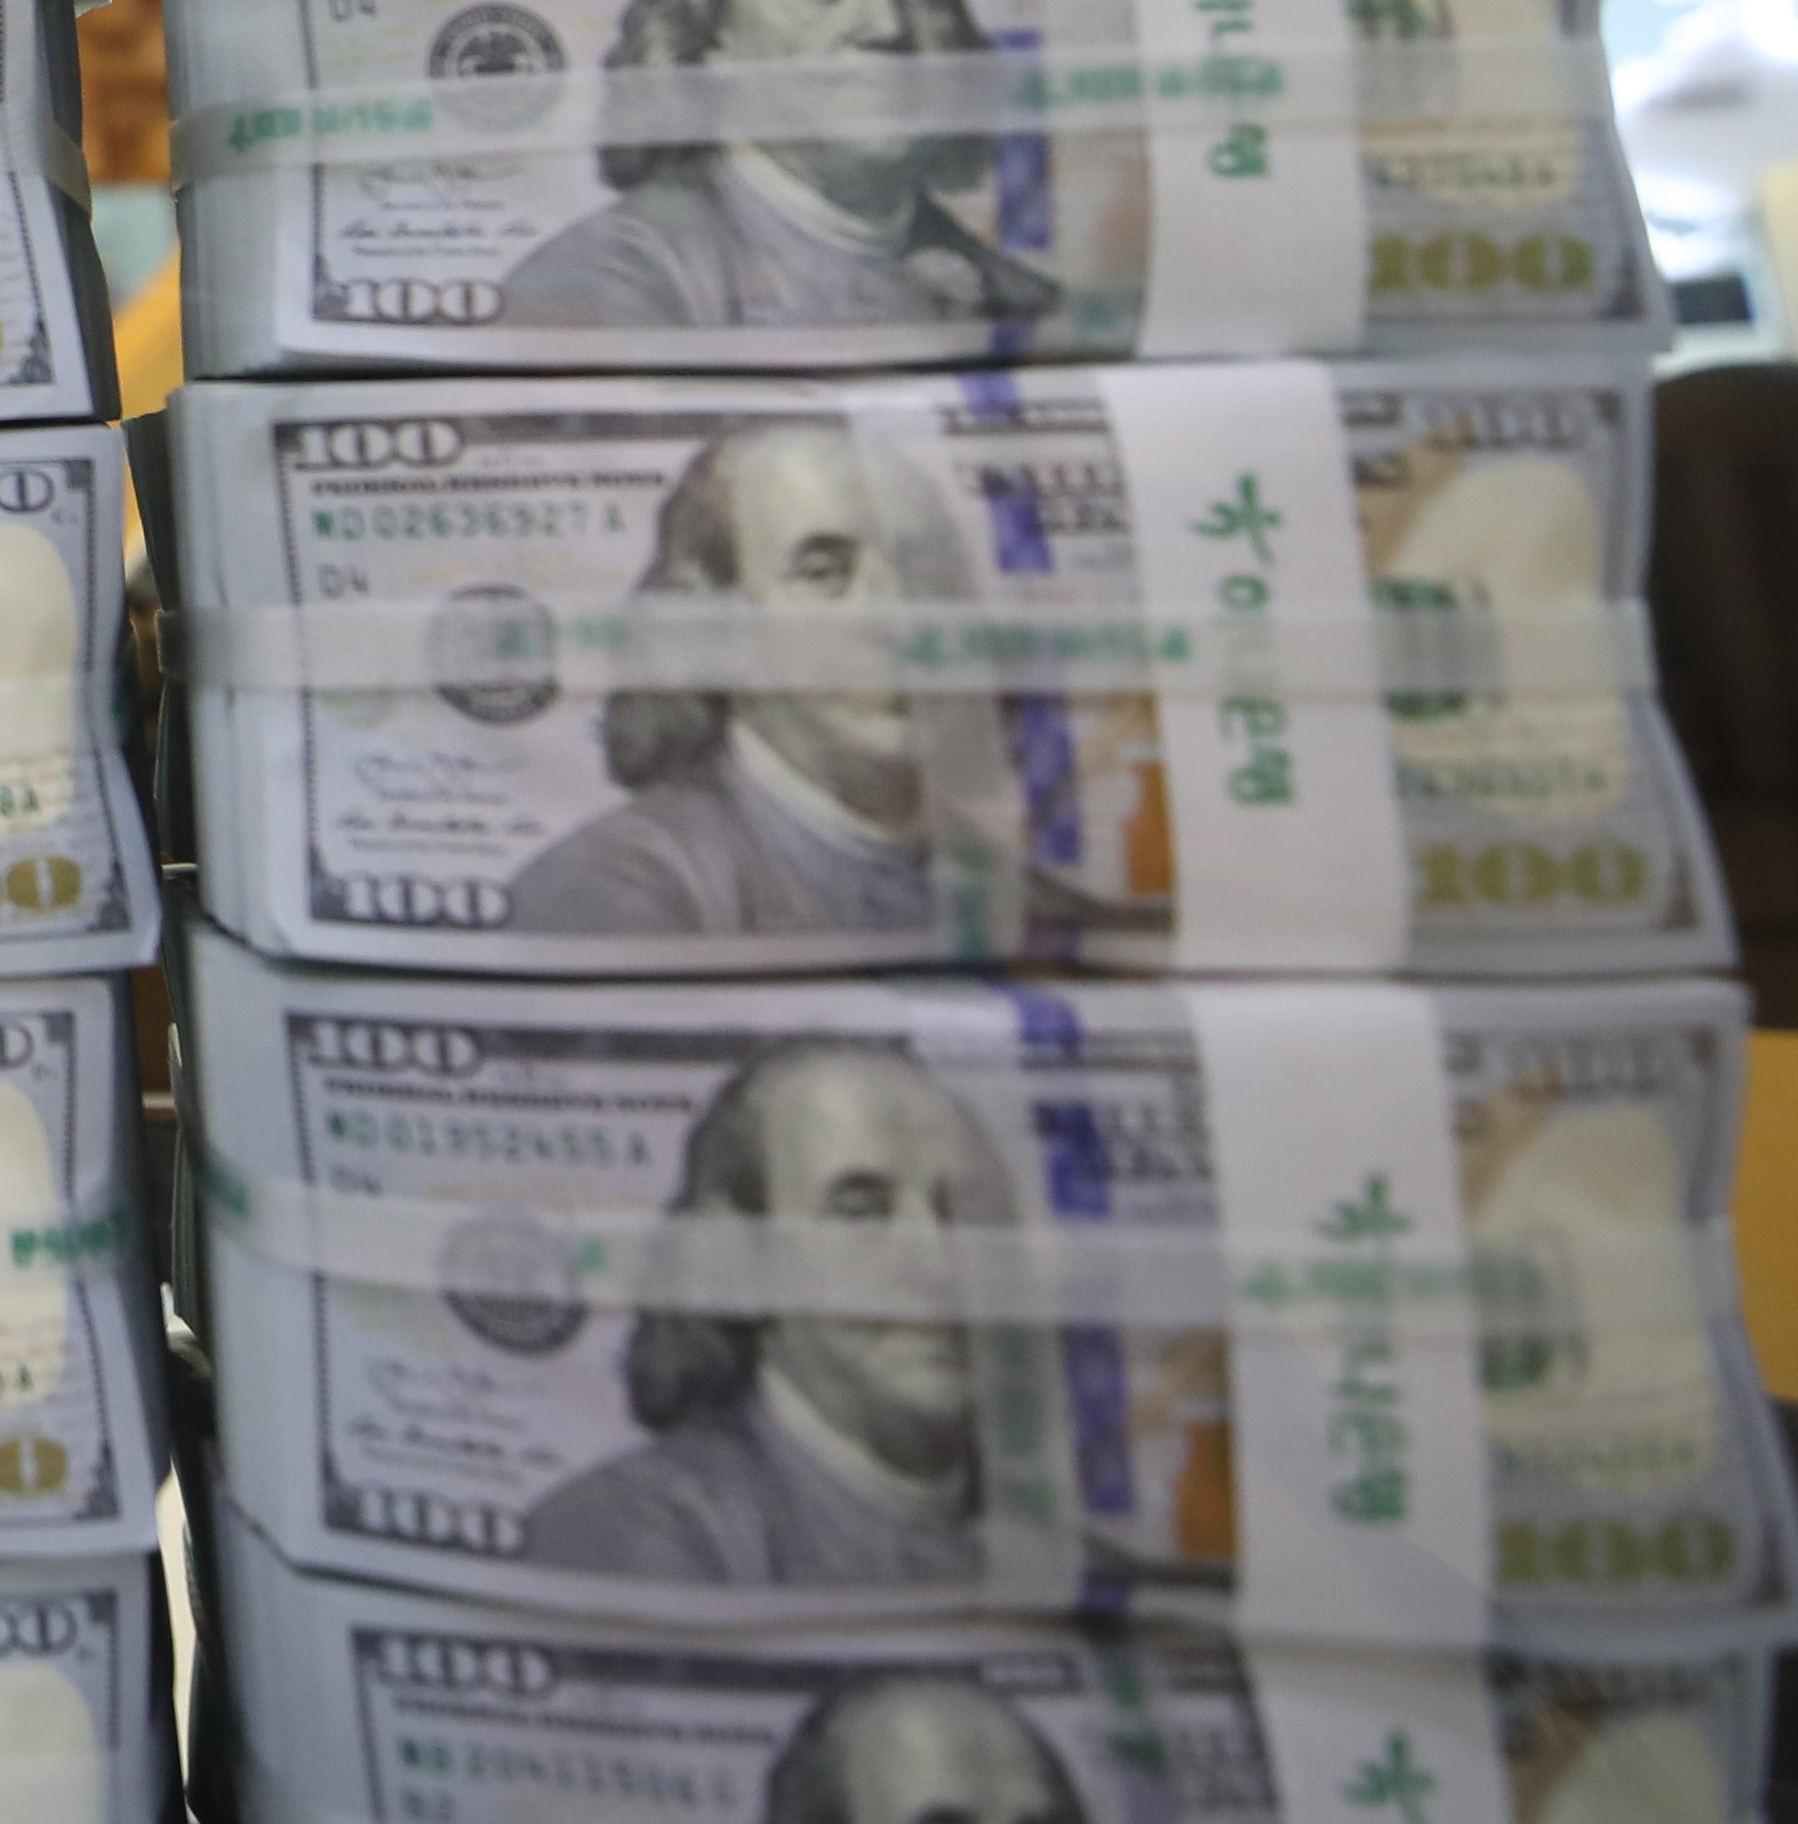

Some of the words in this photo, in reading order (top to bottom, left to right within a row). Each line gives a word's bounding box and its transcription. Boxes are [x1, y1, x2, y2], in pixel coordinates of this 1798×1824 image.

[345, 277, 503, 322] 100
[294, 420, 464, 472] 100
[341, 876, 509, 926] 100
[306, 1017, 483, 1075] 100
